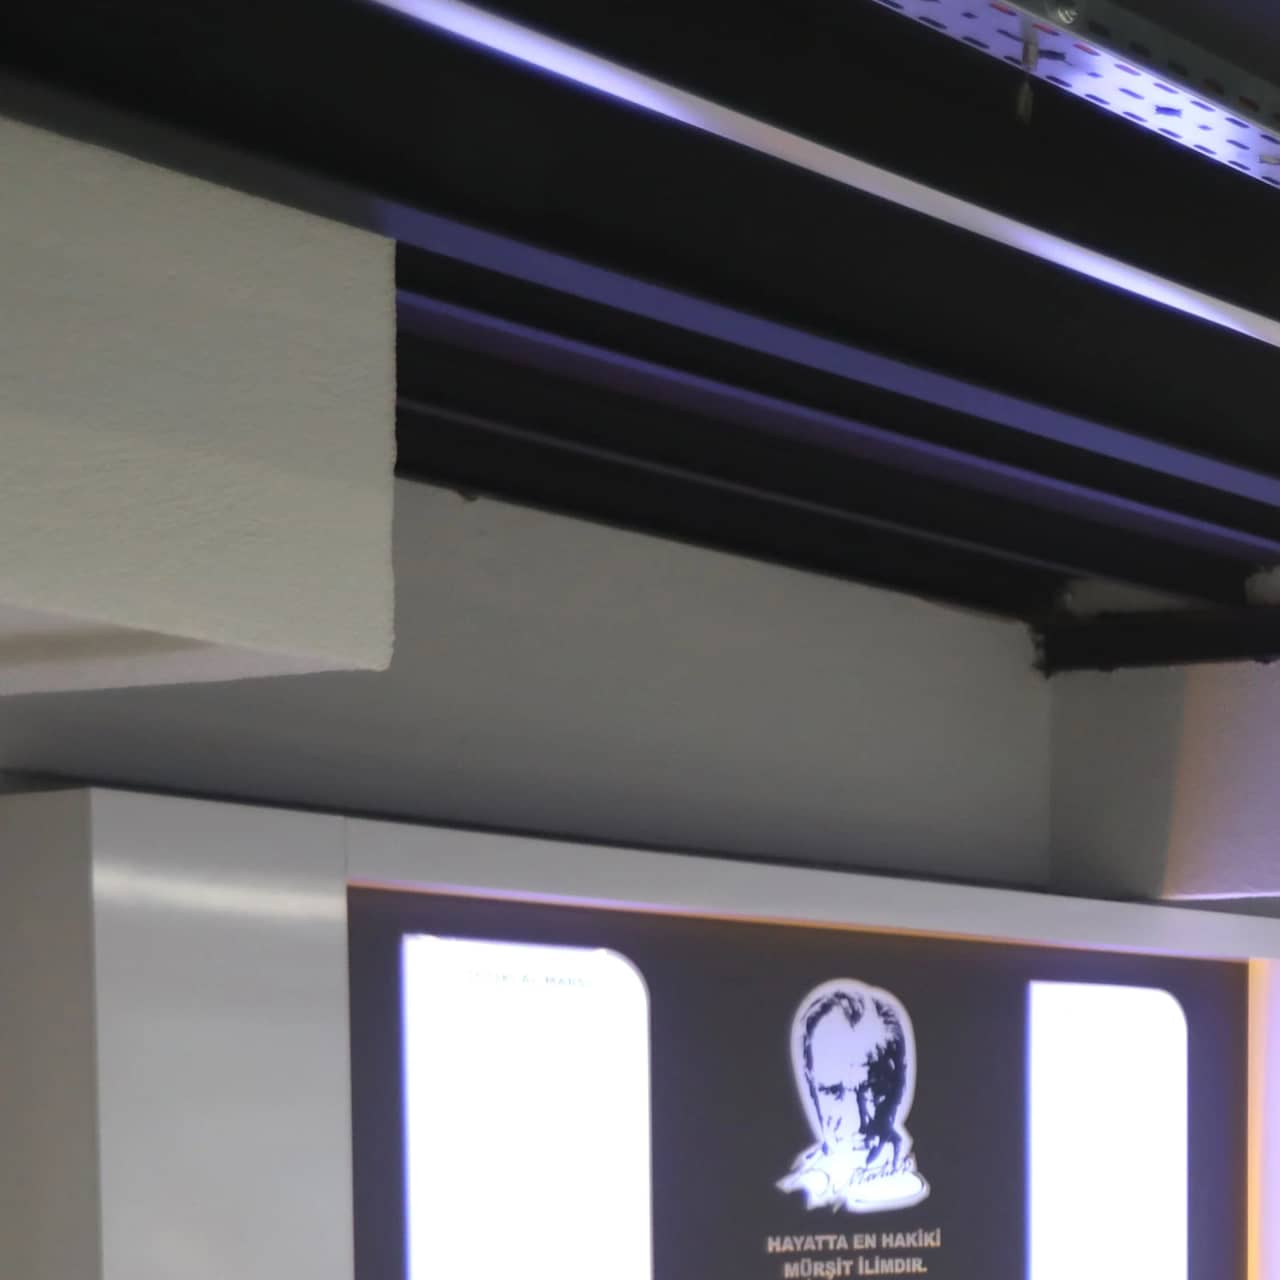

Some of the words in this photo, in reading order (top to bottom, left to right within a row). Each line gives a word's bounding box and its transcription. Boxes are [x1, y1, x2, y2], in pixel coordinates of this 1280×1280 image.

[767, 1234, 849, 1253] HAYATTA
[853, 1232, 877, 1250] EN
[881, 1227, 942, 1248] HAKİKİ
[783, 1256, 854, 1280] MÜRŞİT
